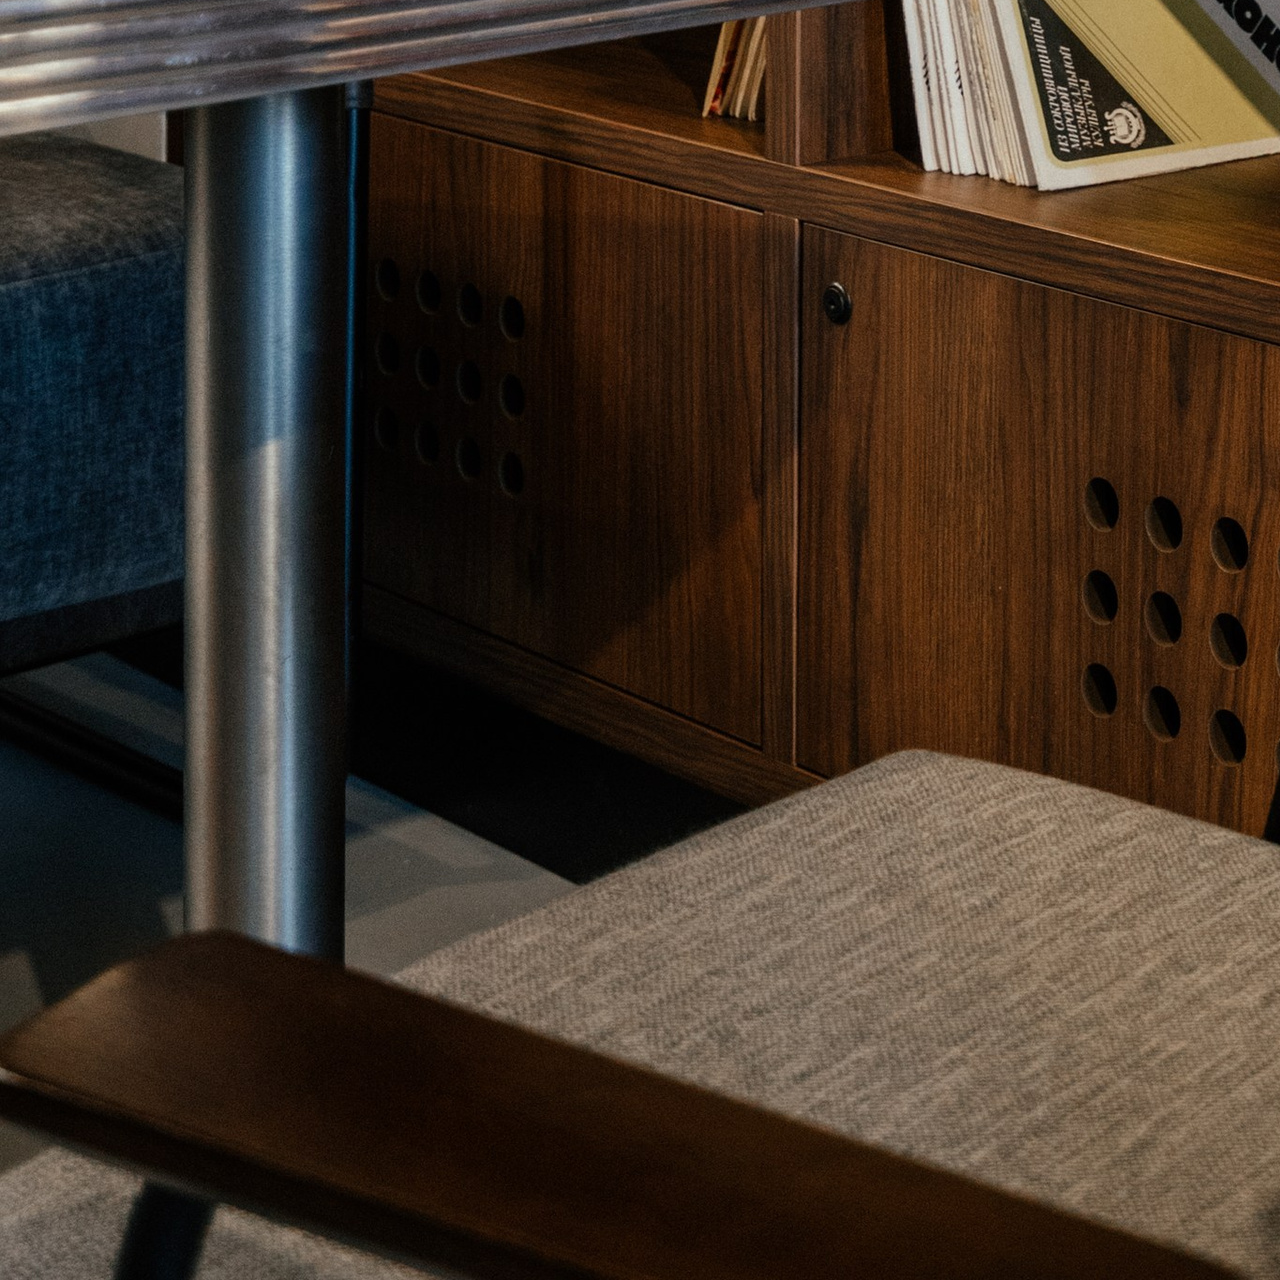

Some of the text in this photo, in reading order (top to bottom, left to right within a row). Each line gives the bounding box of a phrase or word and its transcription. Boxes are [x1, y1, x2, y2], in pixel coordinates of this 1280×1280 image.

[1030, 16, 1071, 153] ИЗ СОКРОВИЩНИЦЫ
[1056, 85, 1083, 151] МИРОВОЙ
[1059, 45, 1094, 149] МУЗЫКАЛЬНОЙ
[1078, 78, 1105, 148] КУЛЬТУРЫ
